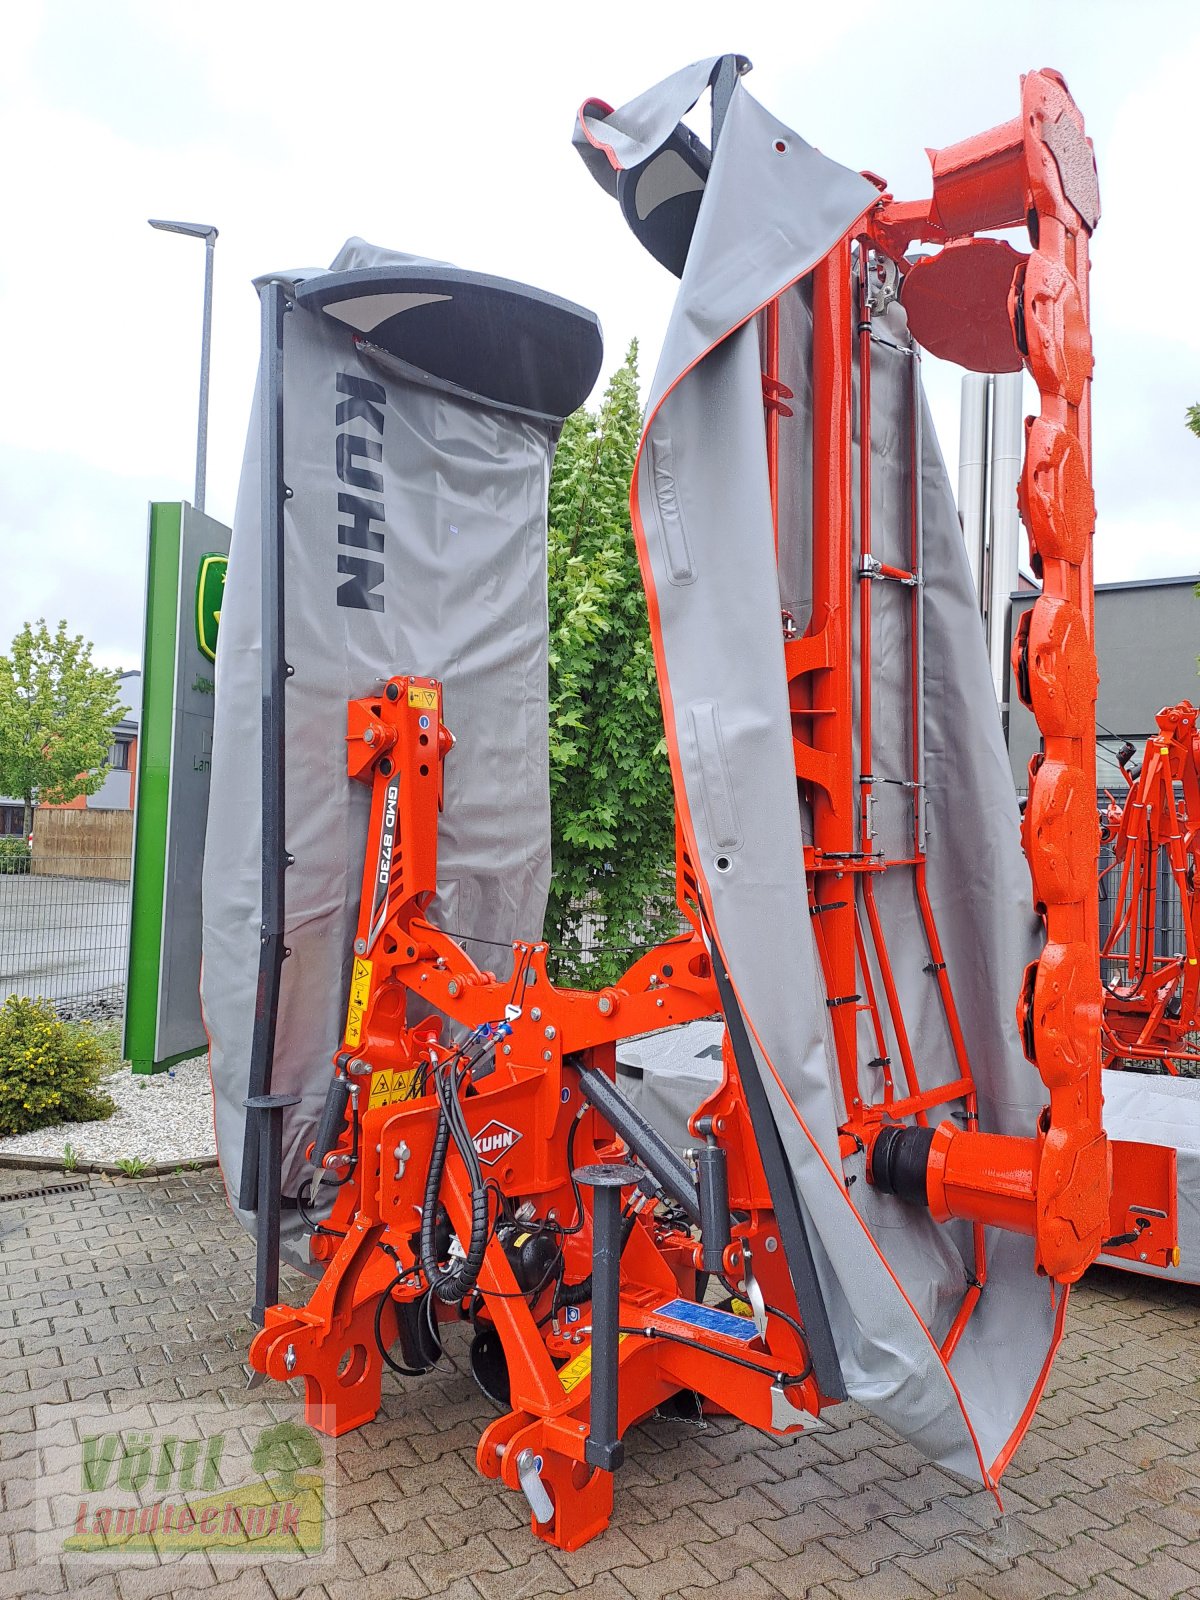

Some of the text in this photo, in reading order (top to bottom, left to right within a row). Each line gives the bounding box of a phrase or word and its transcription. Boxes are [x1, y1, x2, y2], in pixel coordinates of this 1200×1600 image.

[335, 371, 387, 613] KUHN
[379, 786, 398, 884] GMD 8730
[472, 1131, 513, 1154] KUHN
